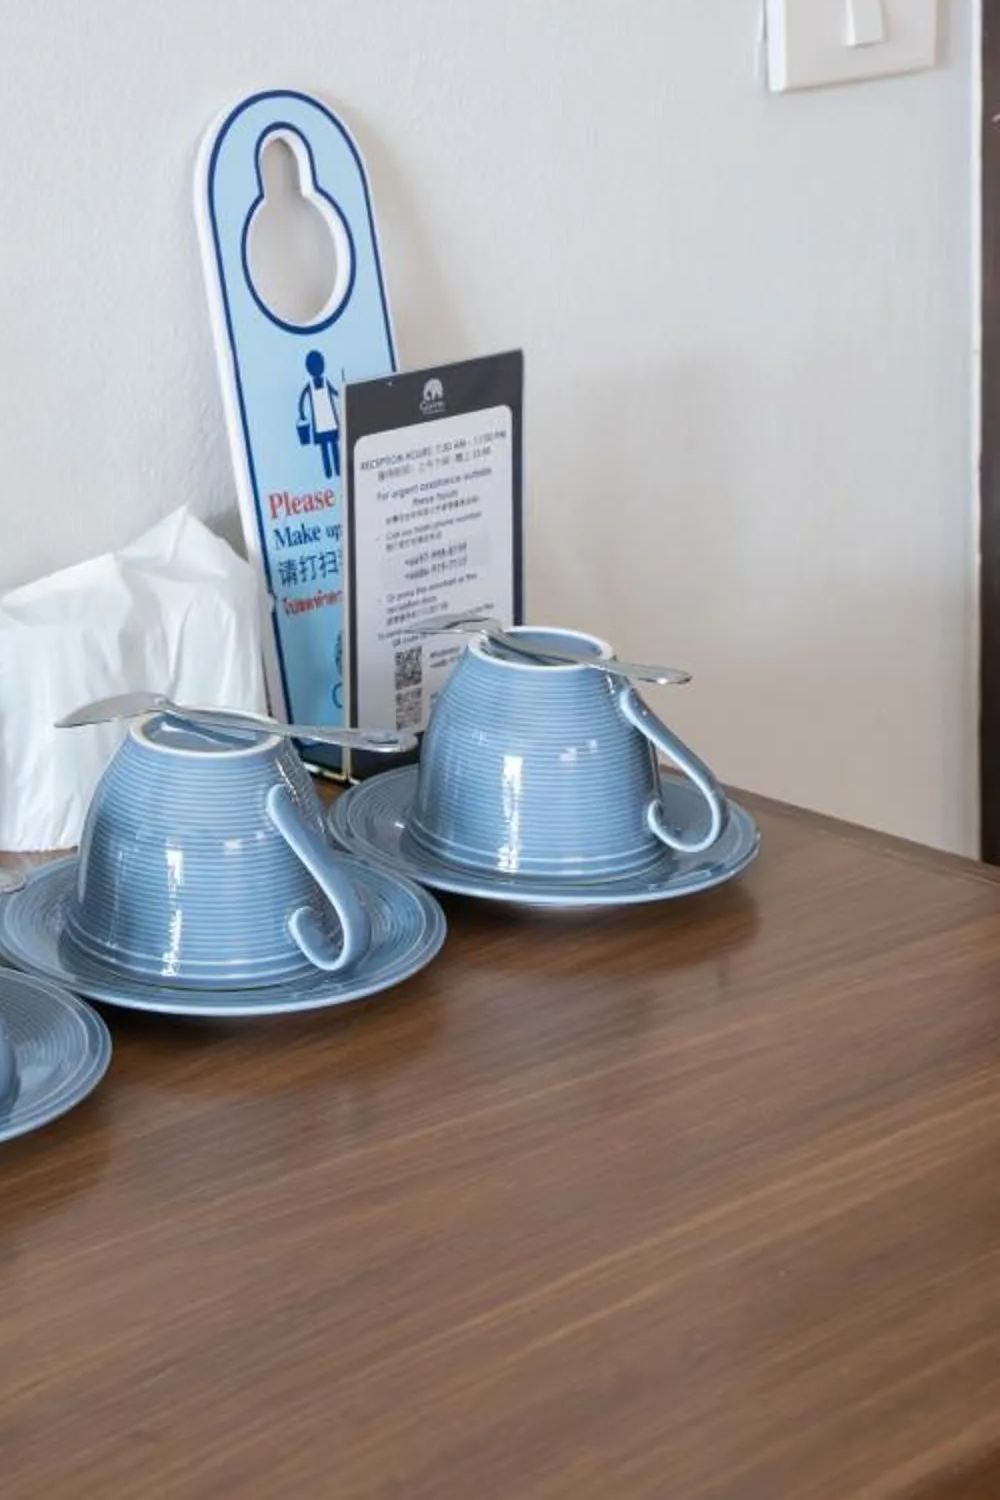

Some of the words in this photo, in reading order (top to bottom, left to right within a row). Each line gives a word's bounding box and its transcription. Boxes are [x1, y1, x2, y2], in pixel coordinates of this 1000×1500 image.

[269, 489, 335, 519] Please
[273, 523, 321, 550] Make
[278, 549, 343, 587] 请打扫
